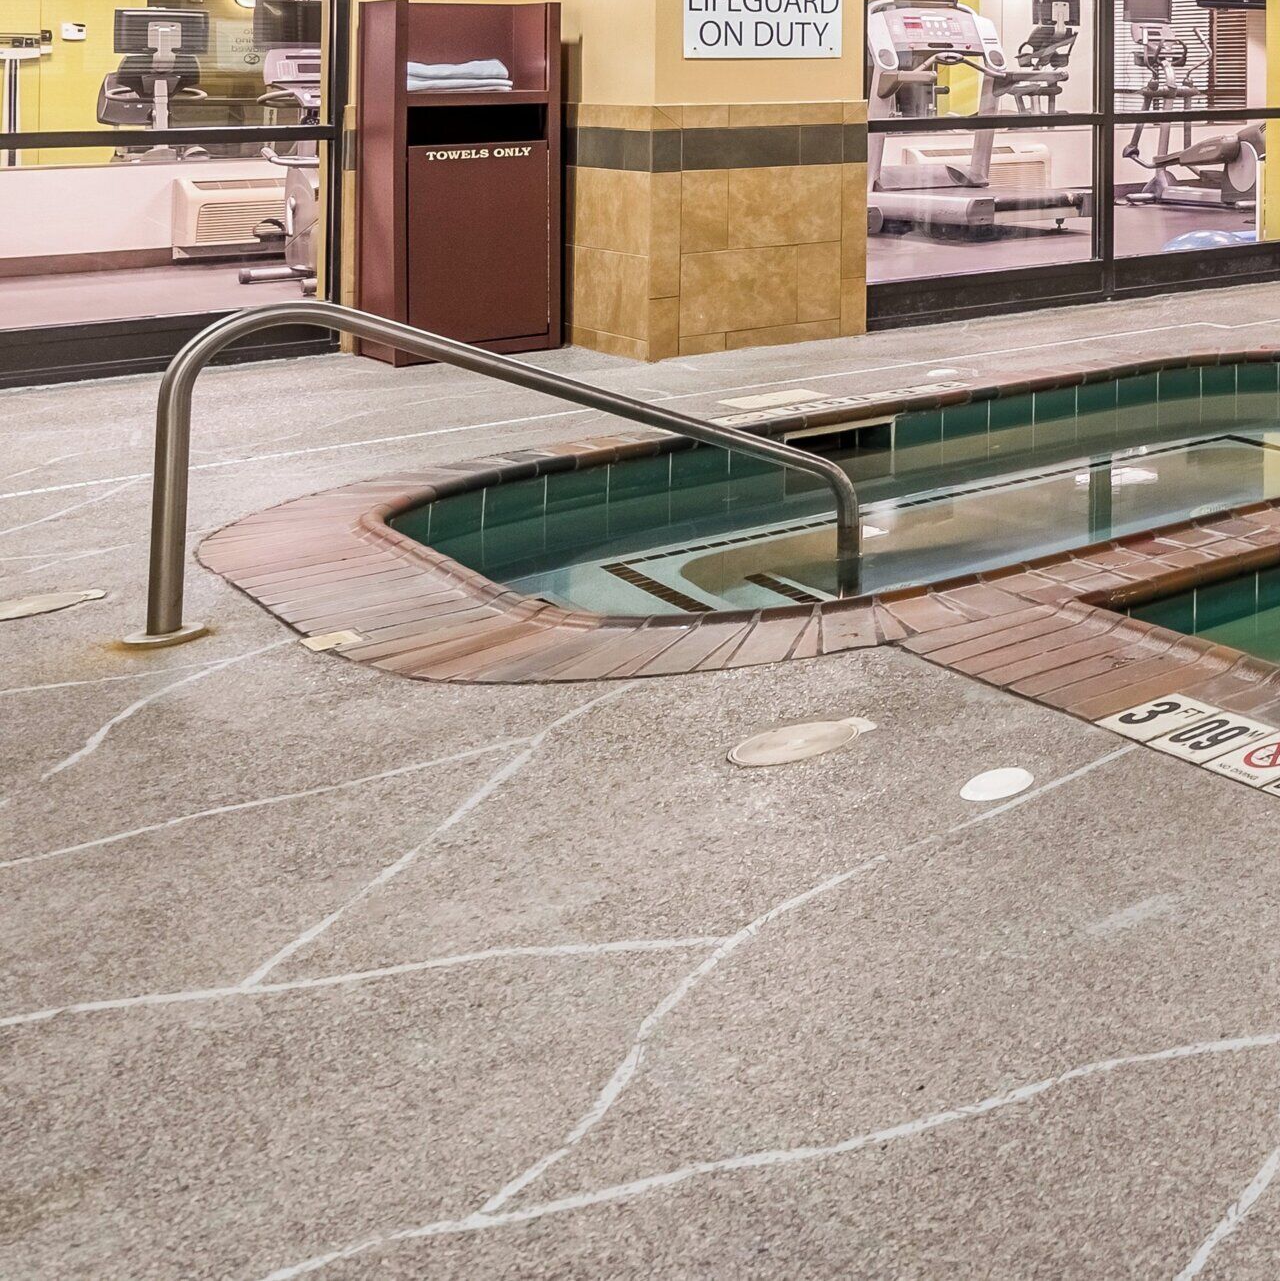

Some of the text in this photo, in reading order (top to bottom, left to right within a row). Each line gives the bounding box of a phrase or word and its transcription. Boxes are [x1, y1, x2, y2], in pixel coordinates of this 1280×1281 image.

[699, 20, 829, 46] ON DUTY
[426, 147, 532, 161] TOWELS ONLY
[1118, 701, 1181, 725] 3
[1174, 707, 1205, 719] FT
